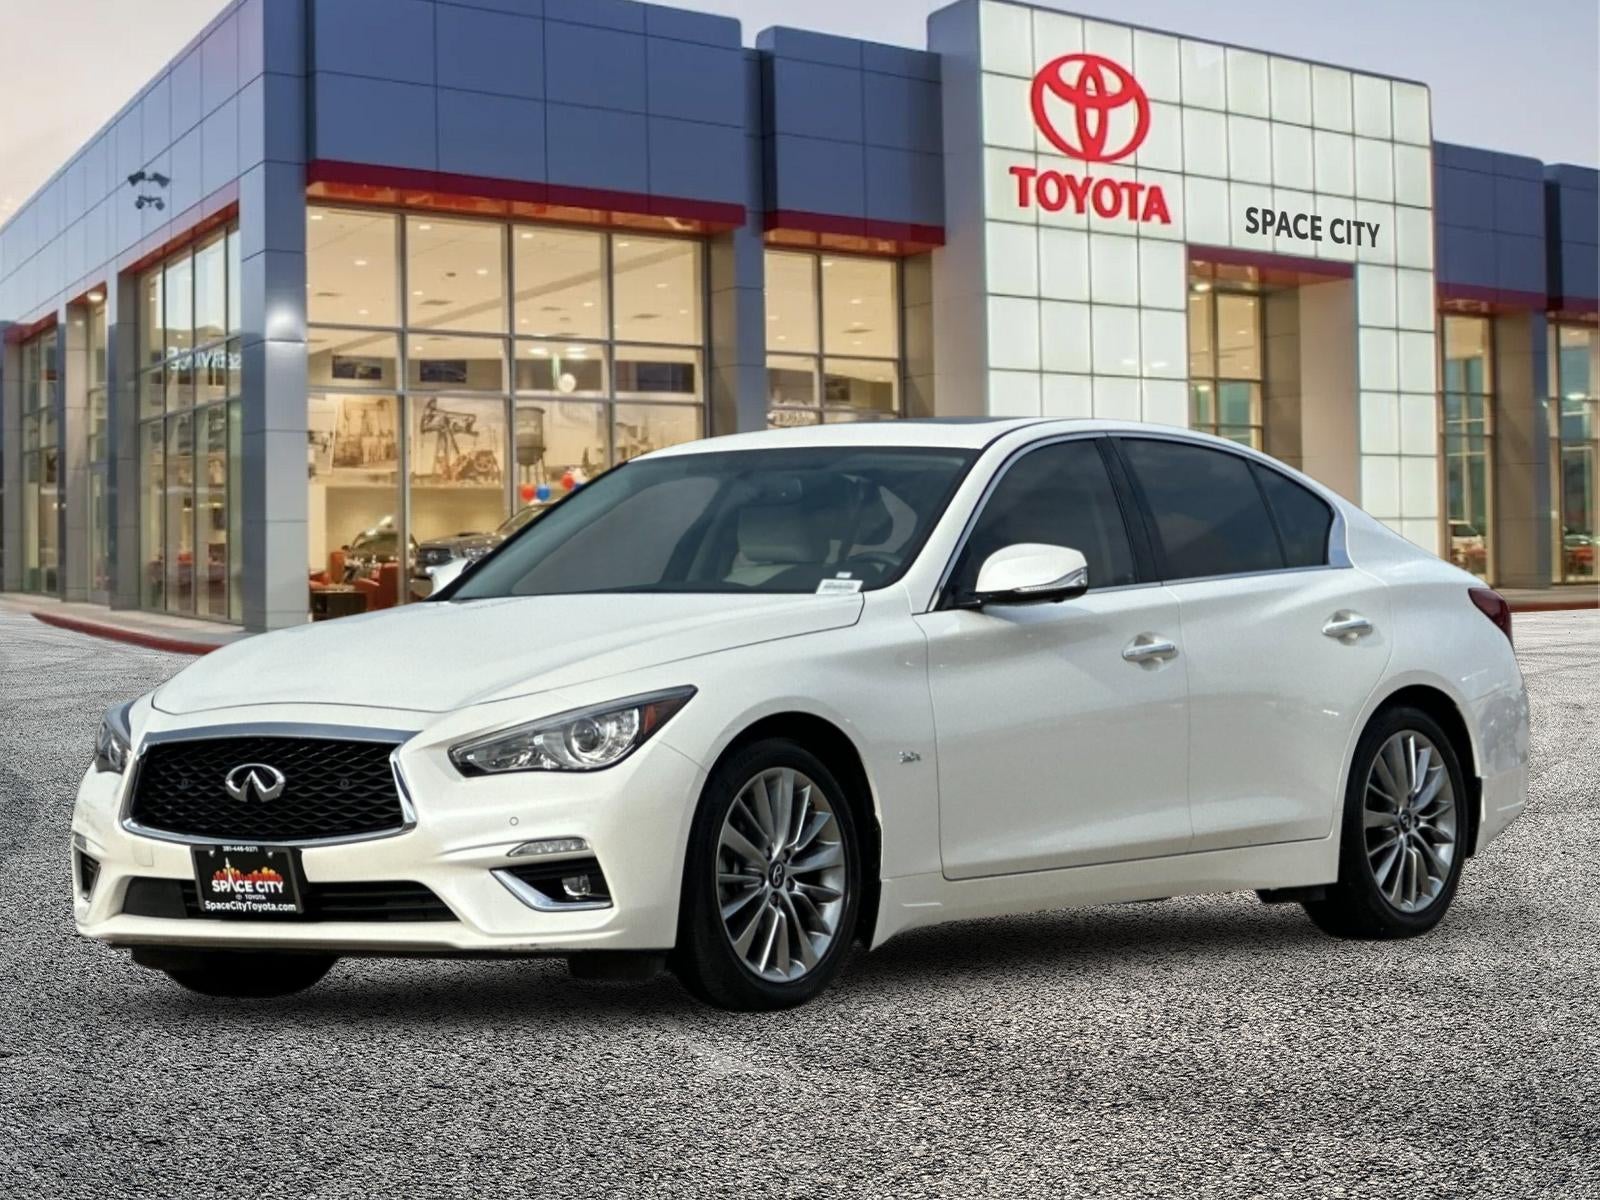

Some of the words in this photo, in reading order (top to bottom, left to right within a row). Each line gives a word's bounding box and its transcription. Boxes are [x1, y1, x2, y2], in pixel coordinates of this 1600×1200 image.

[1009, 166, 1171, 225] TOYOTA
[1245, 206, 1322, 242] SPACE
[1329, 218, 1381, 248] CITY
[212, 880, 253, 892] SPACE
[255, 881, 284, 893] CITY
[204, 900, 297, 912] SpaceCityToyota.com
